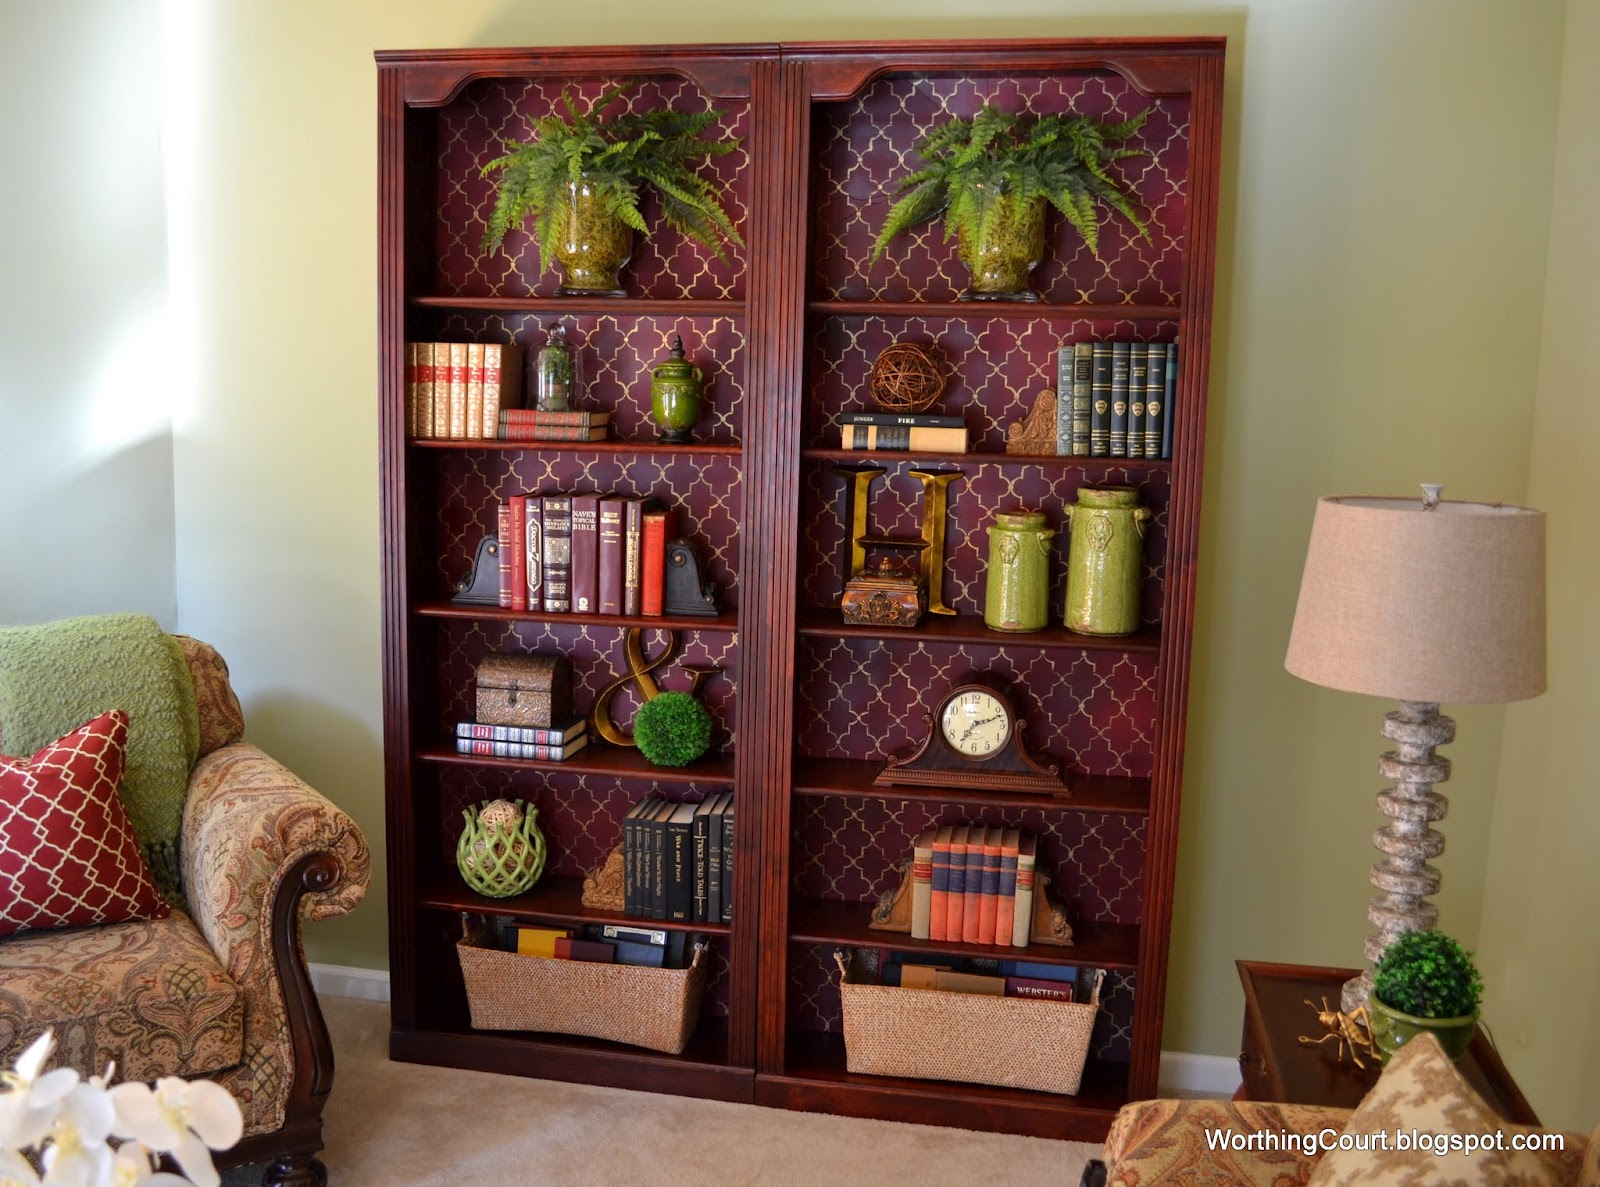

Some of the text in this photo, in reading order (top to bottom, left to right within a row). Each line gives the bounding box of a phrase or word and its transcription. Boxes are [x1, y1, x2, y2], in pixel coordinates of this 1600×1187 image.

[572, 510, 596, 518] NAVE'S
[572, 523, 597, 531] BIBLE
[530, 525, 538, 553] DOCTOR
[960, 696, 968, 707] 11
[971, 693, 981, 704] 12
[950, 705, 959, 715] 10
[1000, 719, 1006, 730] 3
[949, 729, 956, 740] 8
[971, 743, 977, 752] 6
[984, 741, 990, 751] 5
[697, 878, 705, 897] TALES
[1016, 986, 1066, 999] WEBSTER'S
